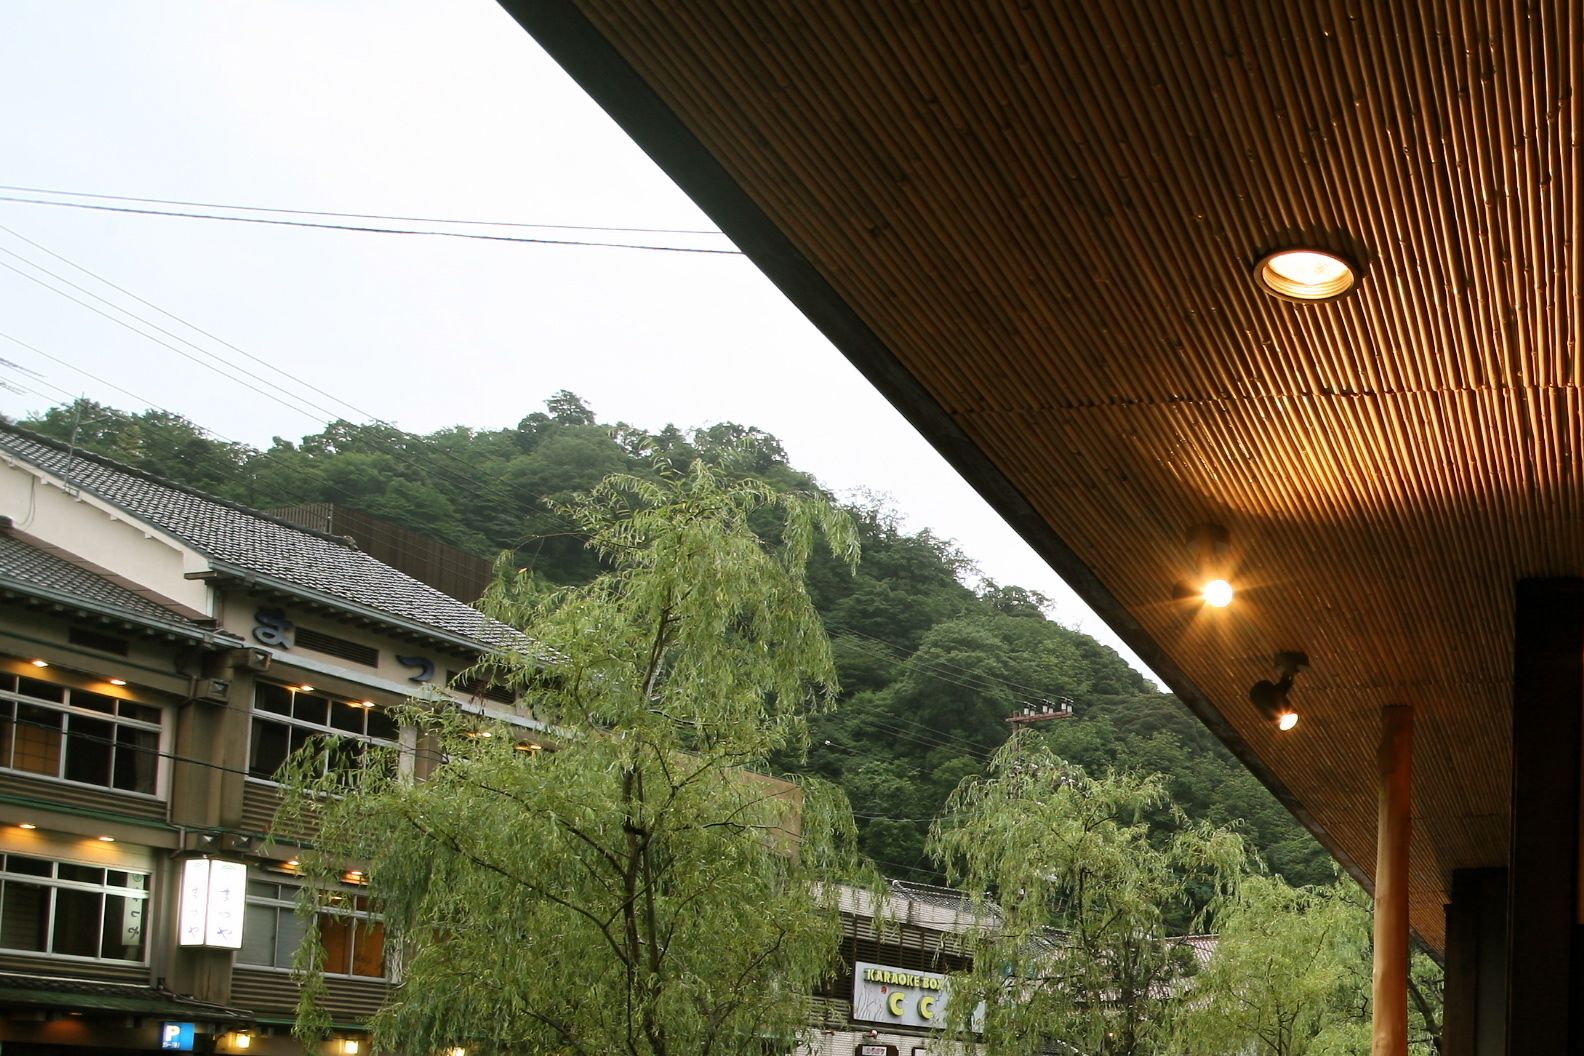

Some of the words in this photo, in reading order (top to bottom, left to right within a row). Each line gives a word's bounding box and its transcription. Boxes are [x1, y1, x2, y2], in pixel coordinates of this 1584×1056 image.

[864, 968, 921, 987] KARAOKE
[922, 976, 945, 991] BOX
[165, 1025, 181, 1042] P
